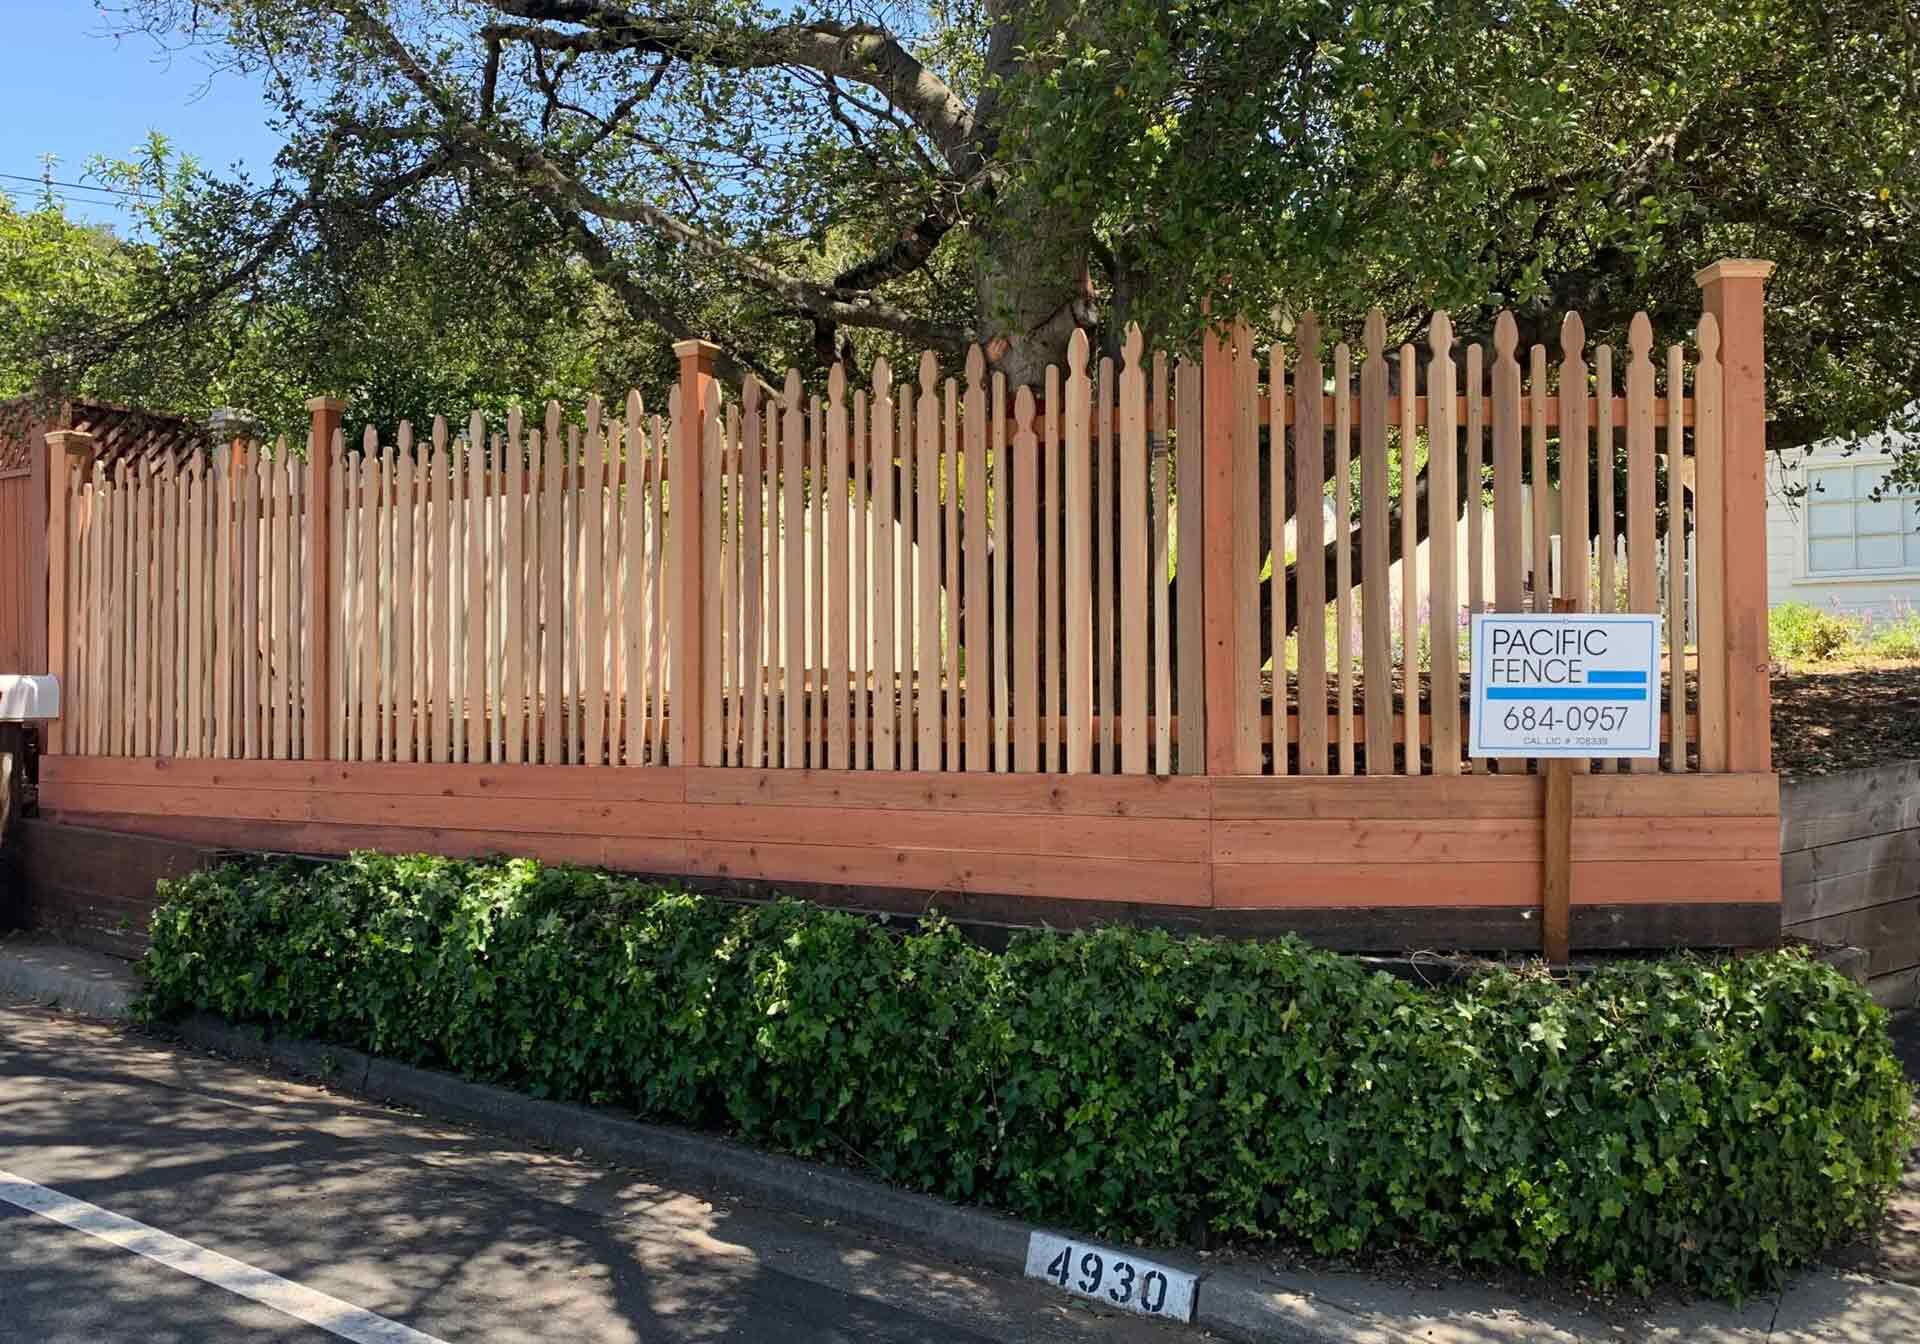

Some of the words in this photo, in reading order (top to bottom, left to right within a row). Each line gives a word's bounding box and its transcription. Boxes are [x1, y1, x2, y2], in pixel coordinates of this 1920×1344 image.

[1492, 629, 1608, 655] PACIFIC
[1491, 658, 1583, 683] FENCE
[1503, 706, 1629, 731] 684-0957
[1047, 1246, 1168, 1312] 4930
